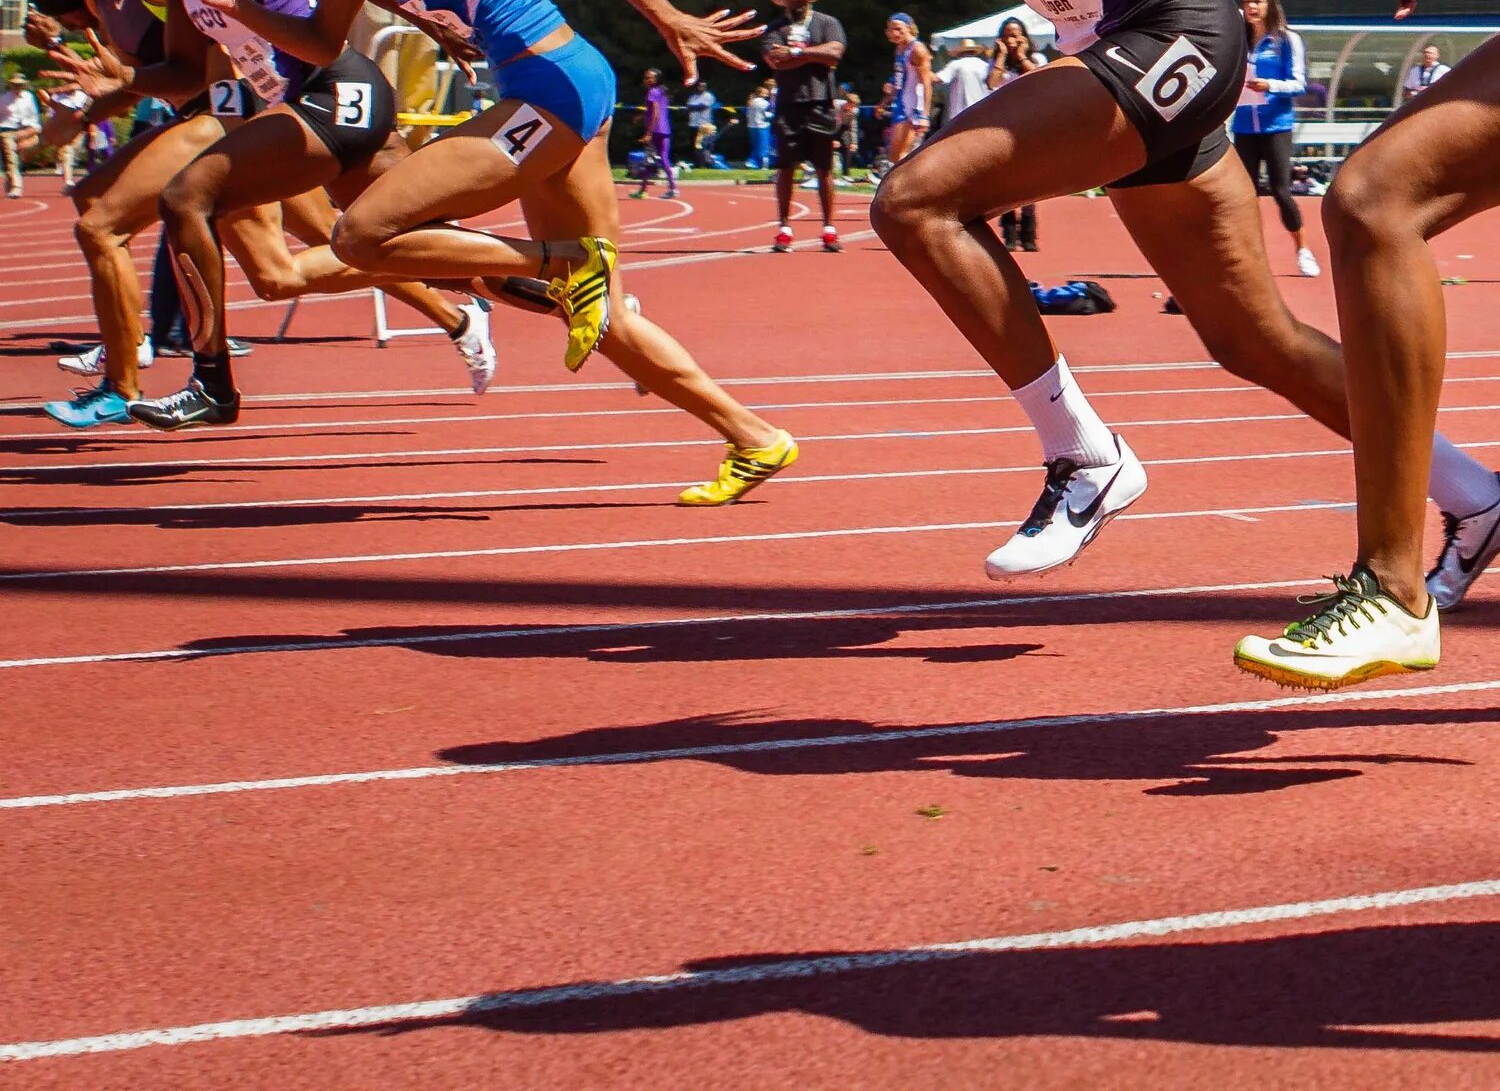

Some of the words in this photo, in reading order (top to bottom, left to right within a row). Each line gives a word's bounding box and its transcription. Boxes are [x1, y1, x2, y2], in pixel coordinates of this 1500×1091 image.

[215, 81, 237, 113] 2
[1152, 53, 1206, 108] 6
[343, 88, 364, 125] 3
[504, 117, 543, 156] 4
